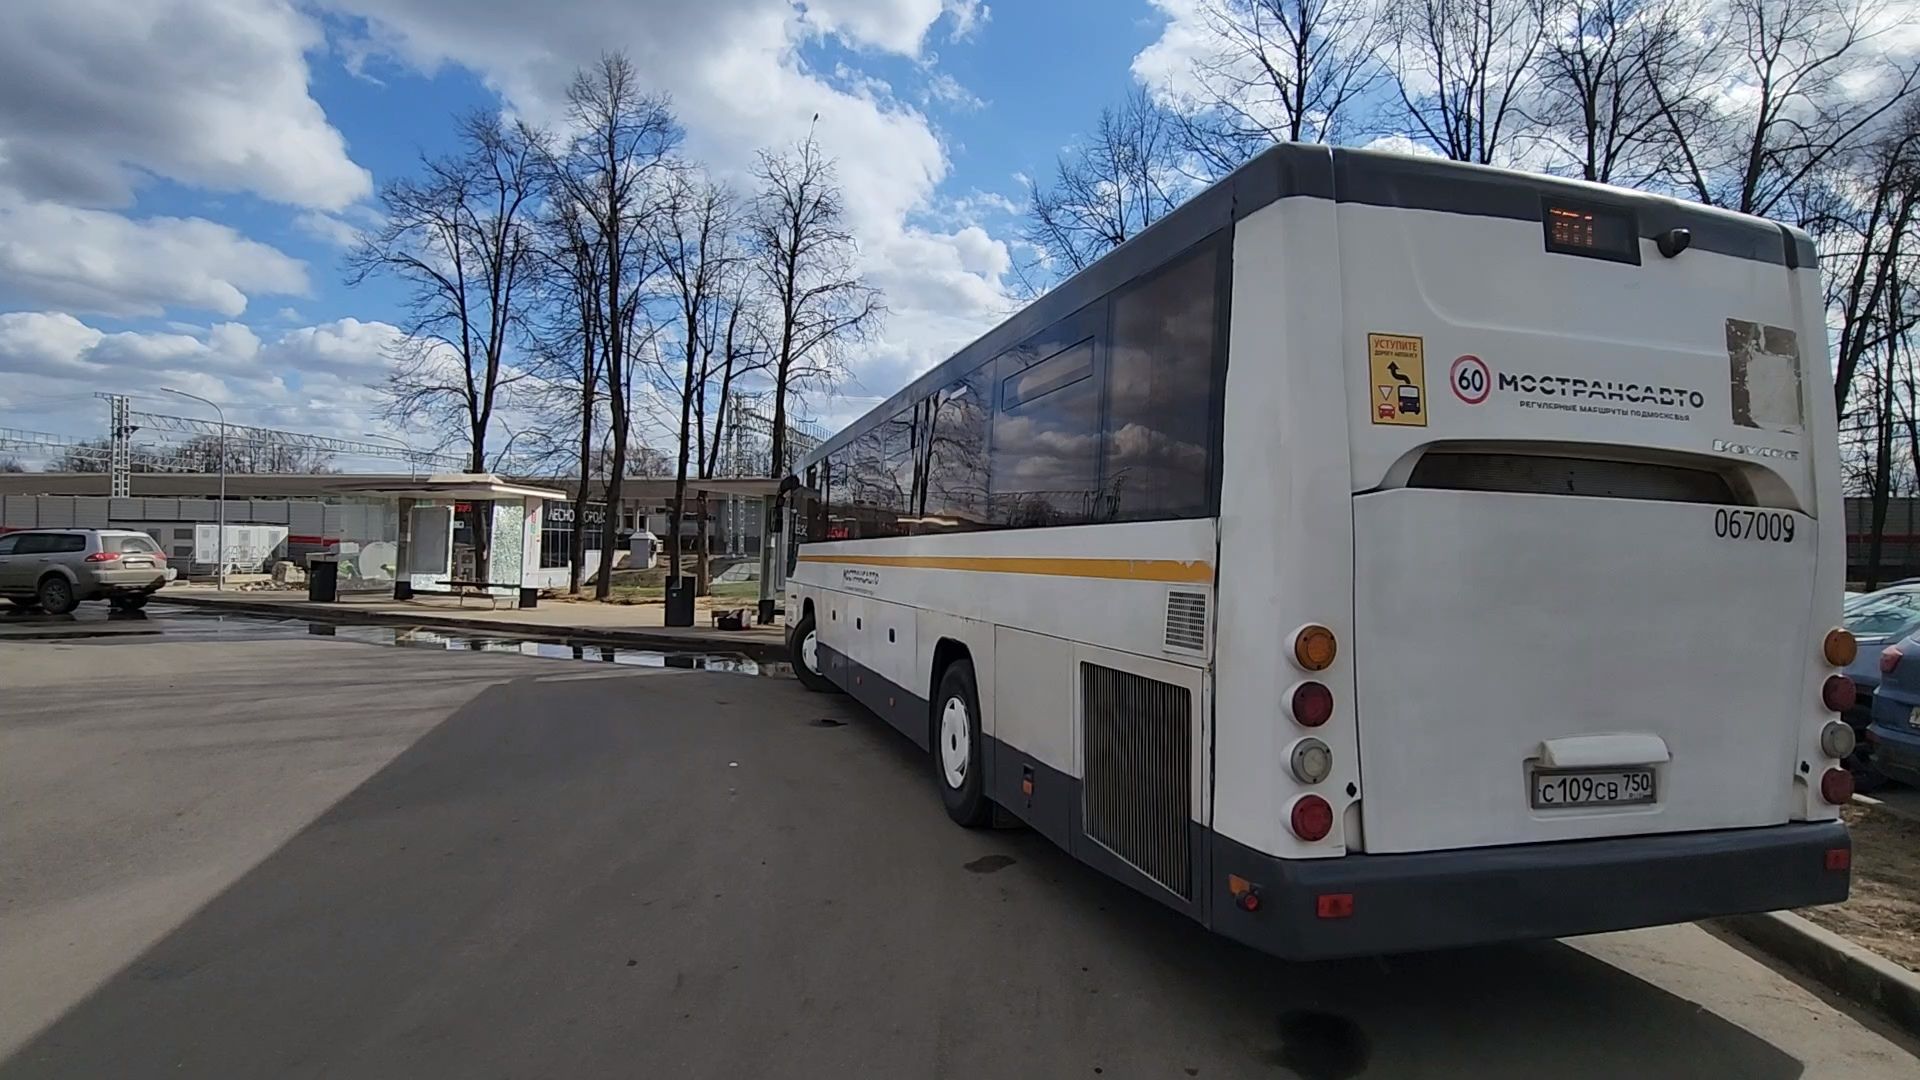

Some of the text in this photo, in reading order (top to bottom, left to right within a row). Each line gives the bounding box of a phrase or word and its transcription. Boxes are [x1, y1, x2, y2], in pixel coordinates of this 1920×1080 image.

[1374, 338, 1418, 352] УСТУПИТЕ
[1458, 367, 1484, 393] 60
[1498, 372, 1705, 409] МОСТРАНСАВТО
[1579, 404, 1629, 417] МАРШРУТЫ
[547, 508, 576, 523] ЛЕСНО
[1715, 508, 1795, 543] 067009
[1623, 773, 1650, 792] 750
